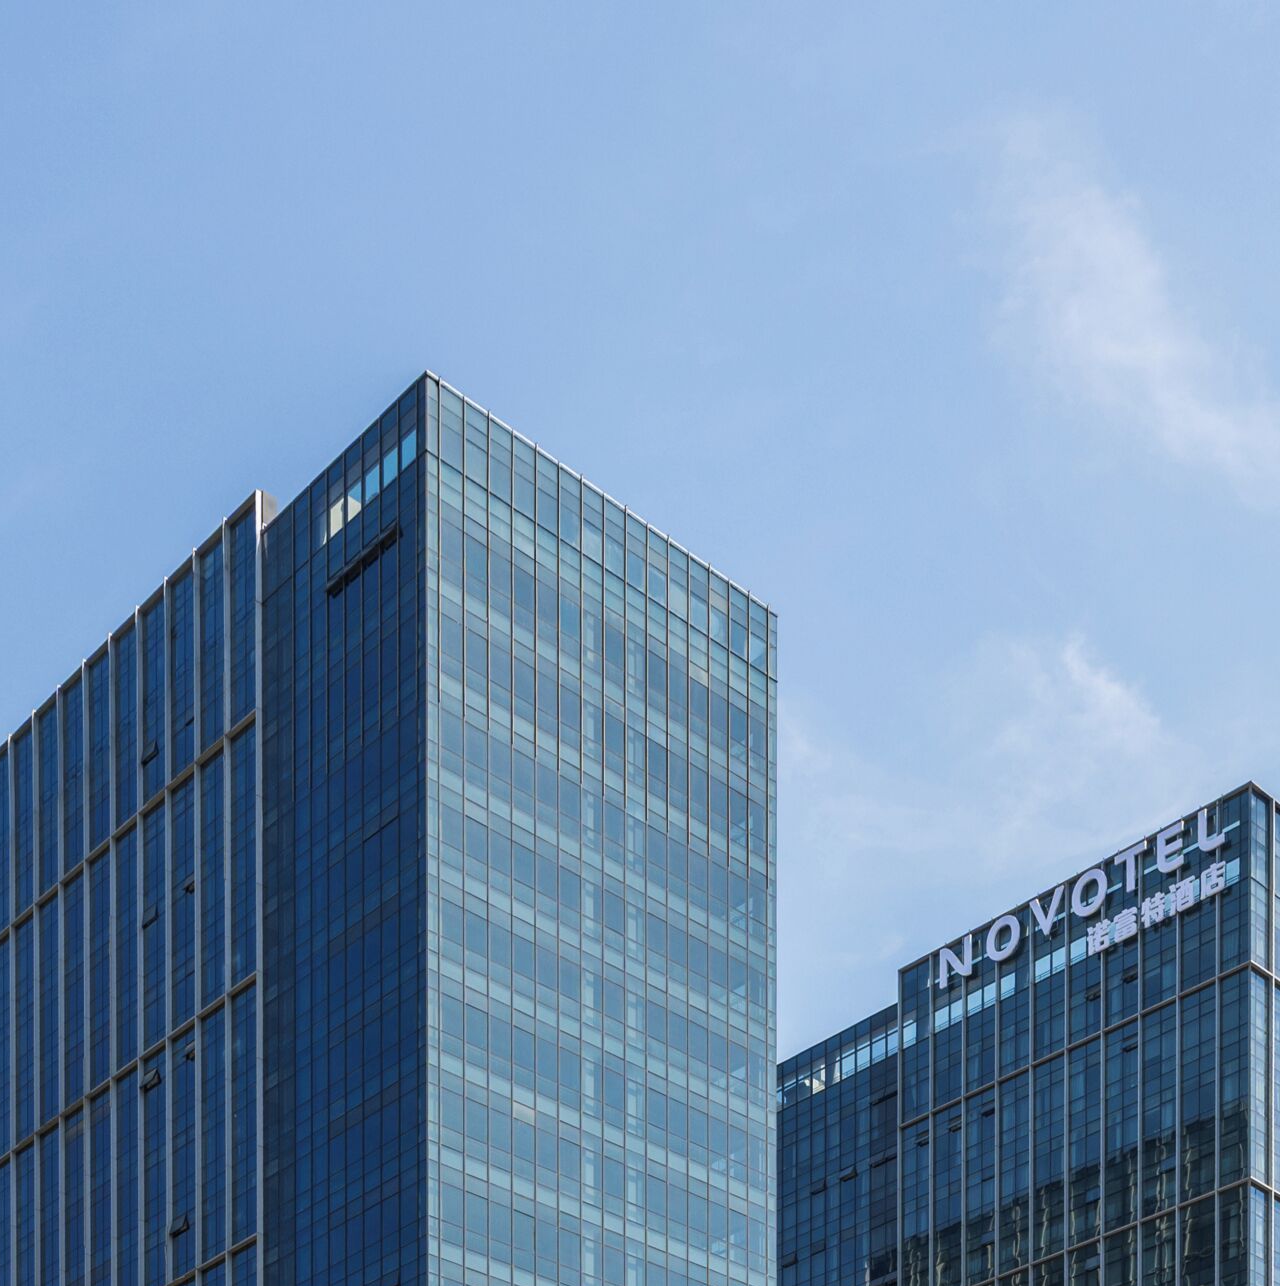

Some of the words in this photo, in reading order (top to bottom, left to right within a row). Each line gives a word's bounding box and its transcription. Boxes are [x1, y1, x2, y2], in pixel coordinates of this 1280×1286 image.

[939, 808, 1226, 990] NOVOTEL
[1086, 860, 1227, 957] 诺富特酒店
